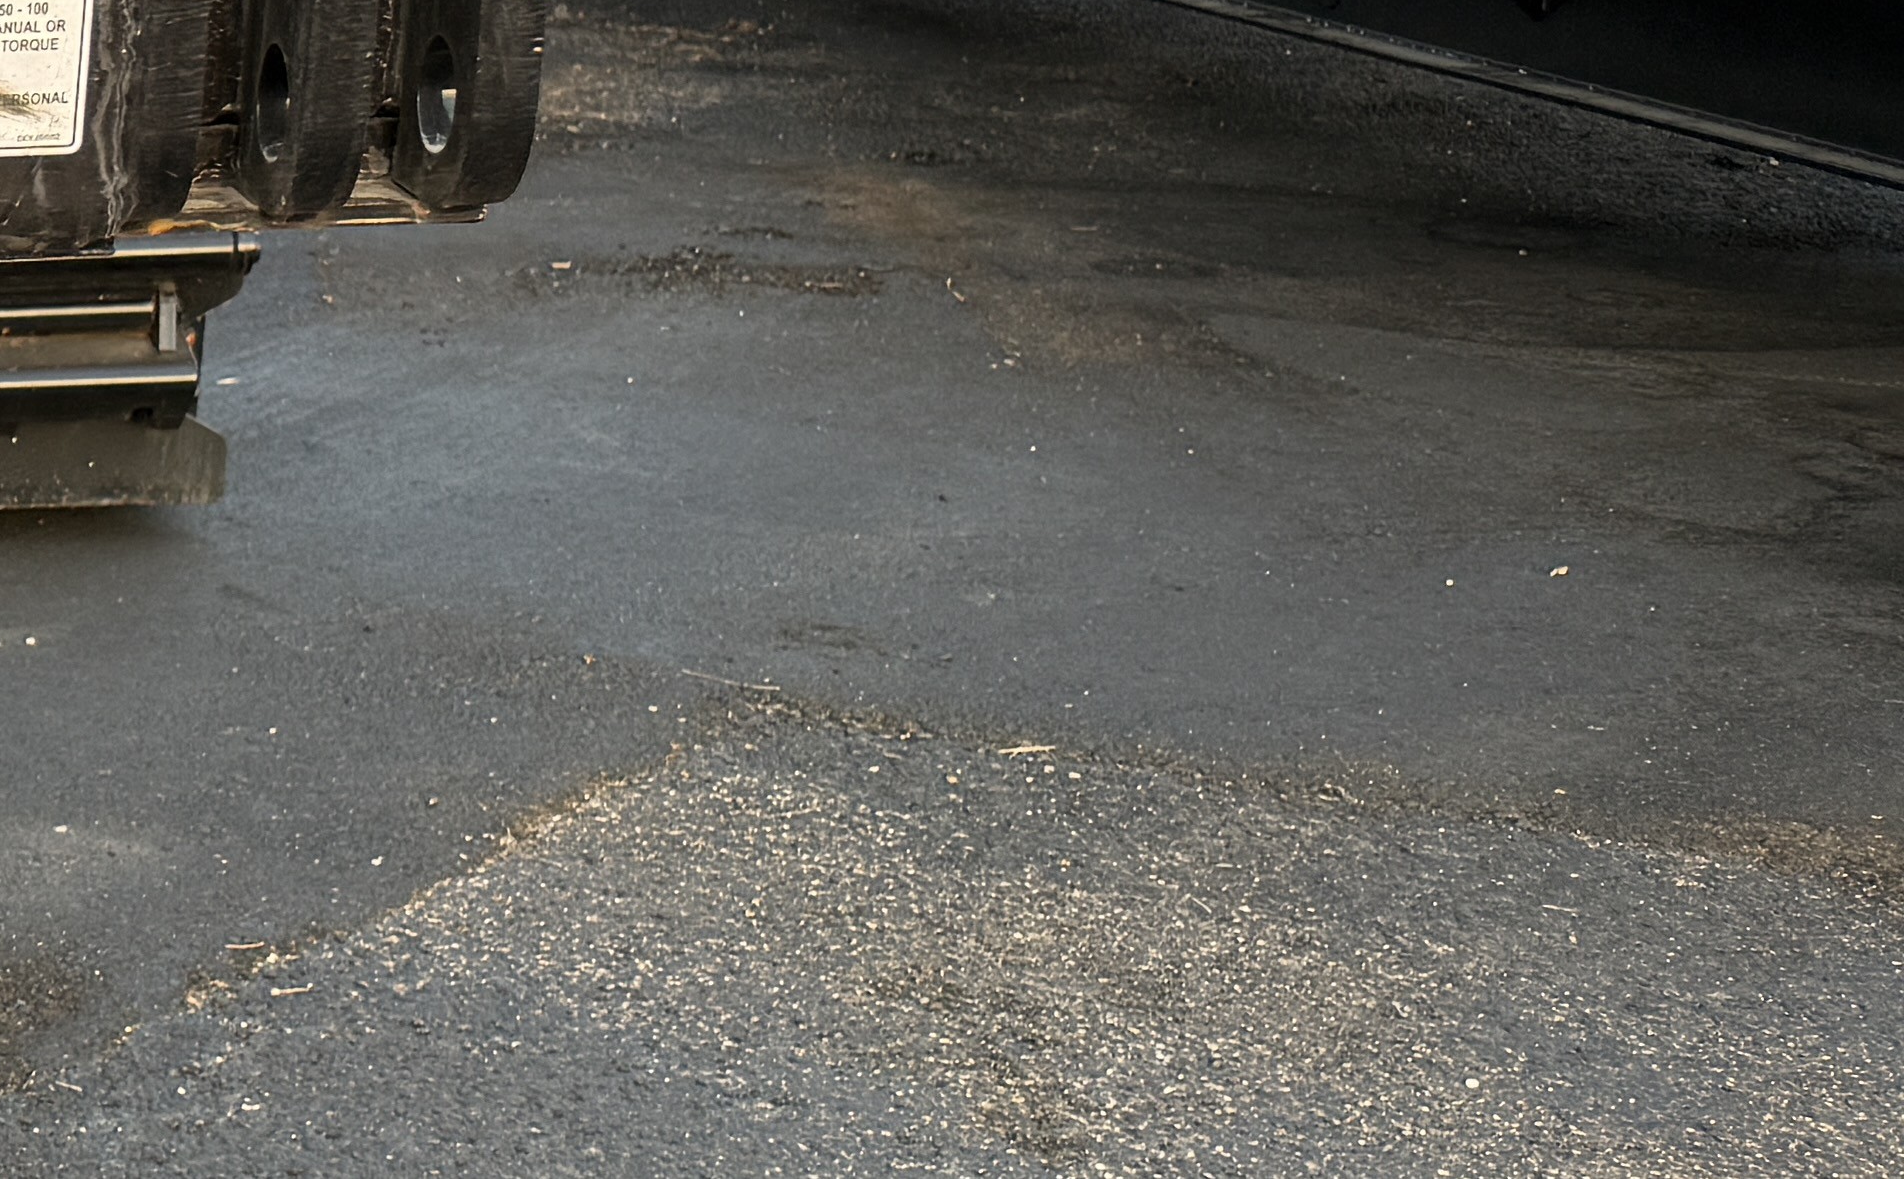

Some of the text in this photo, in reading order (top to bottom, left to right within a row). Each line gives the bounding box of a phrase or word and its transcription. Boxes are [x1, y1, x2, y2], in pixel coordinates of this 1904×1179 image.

[27, 2, 49, 15] 100
[46, 19, 66, 32] OR
[1, 37, 59, 52] TORQUE
